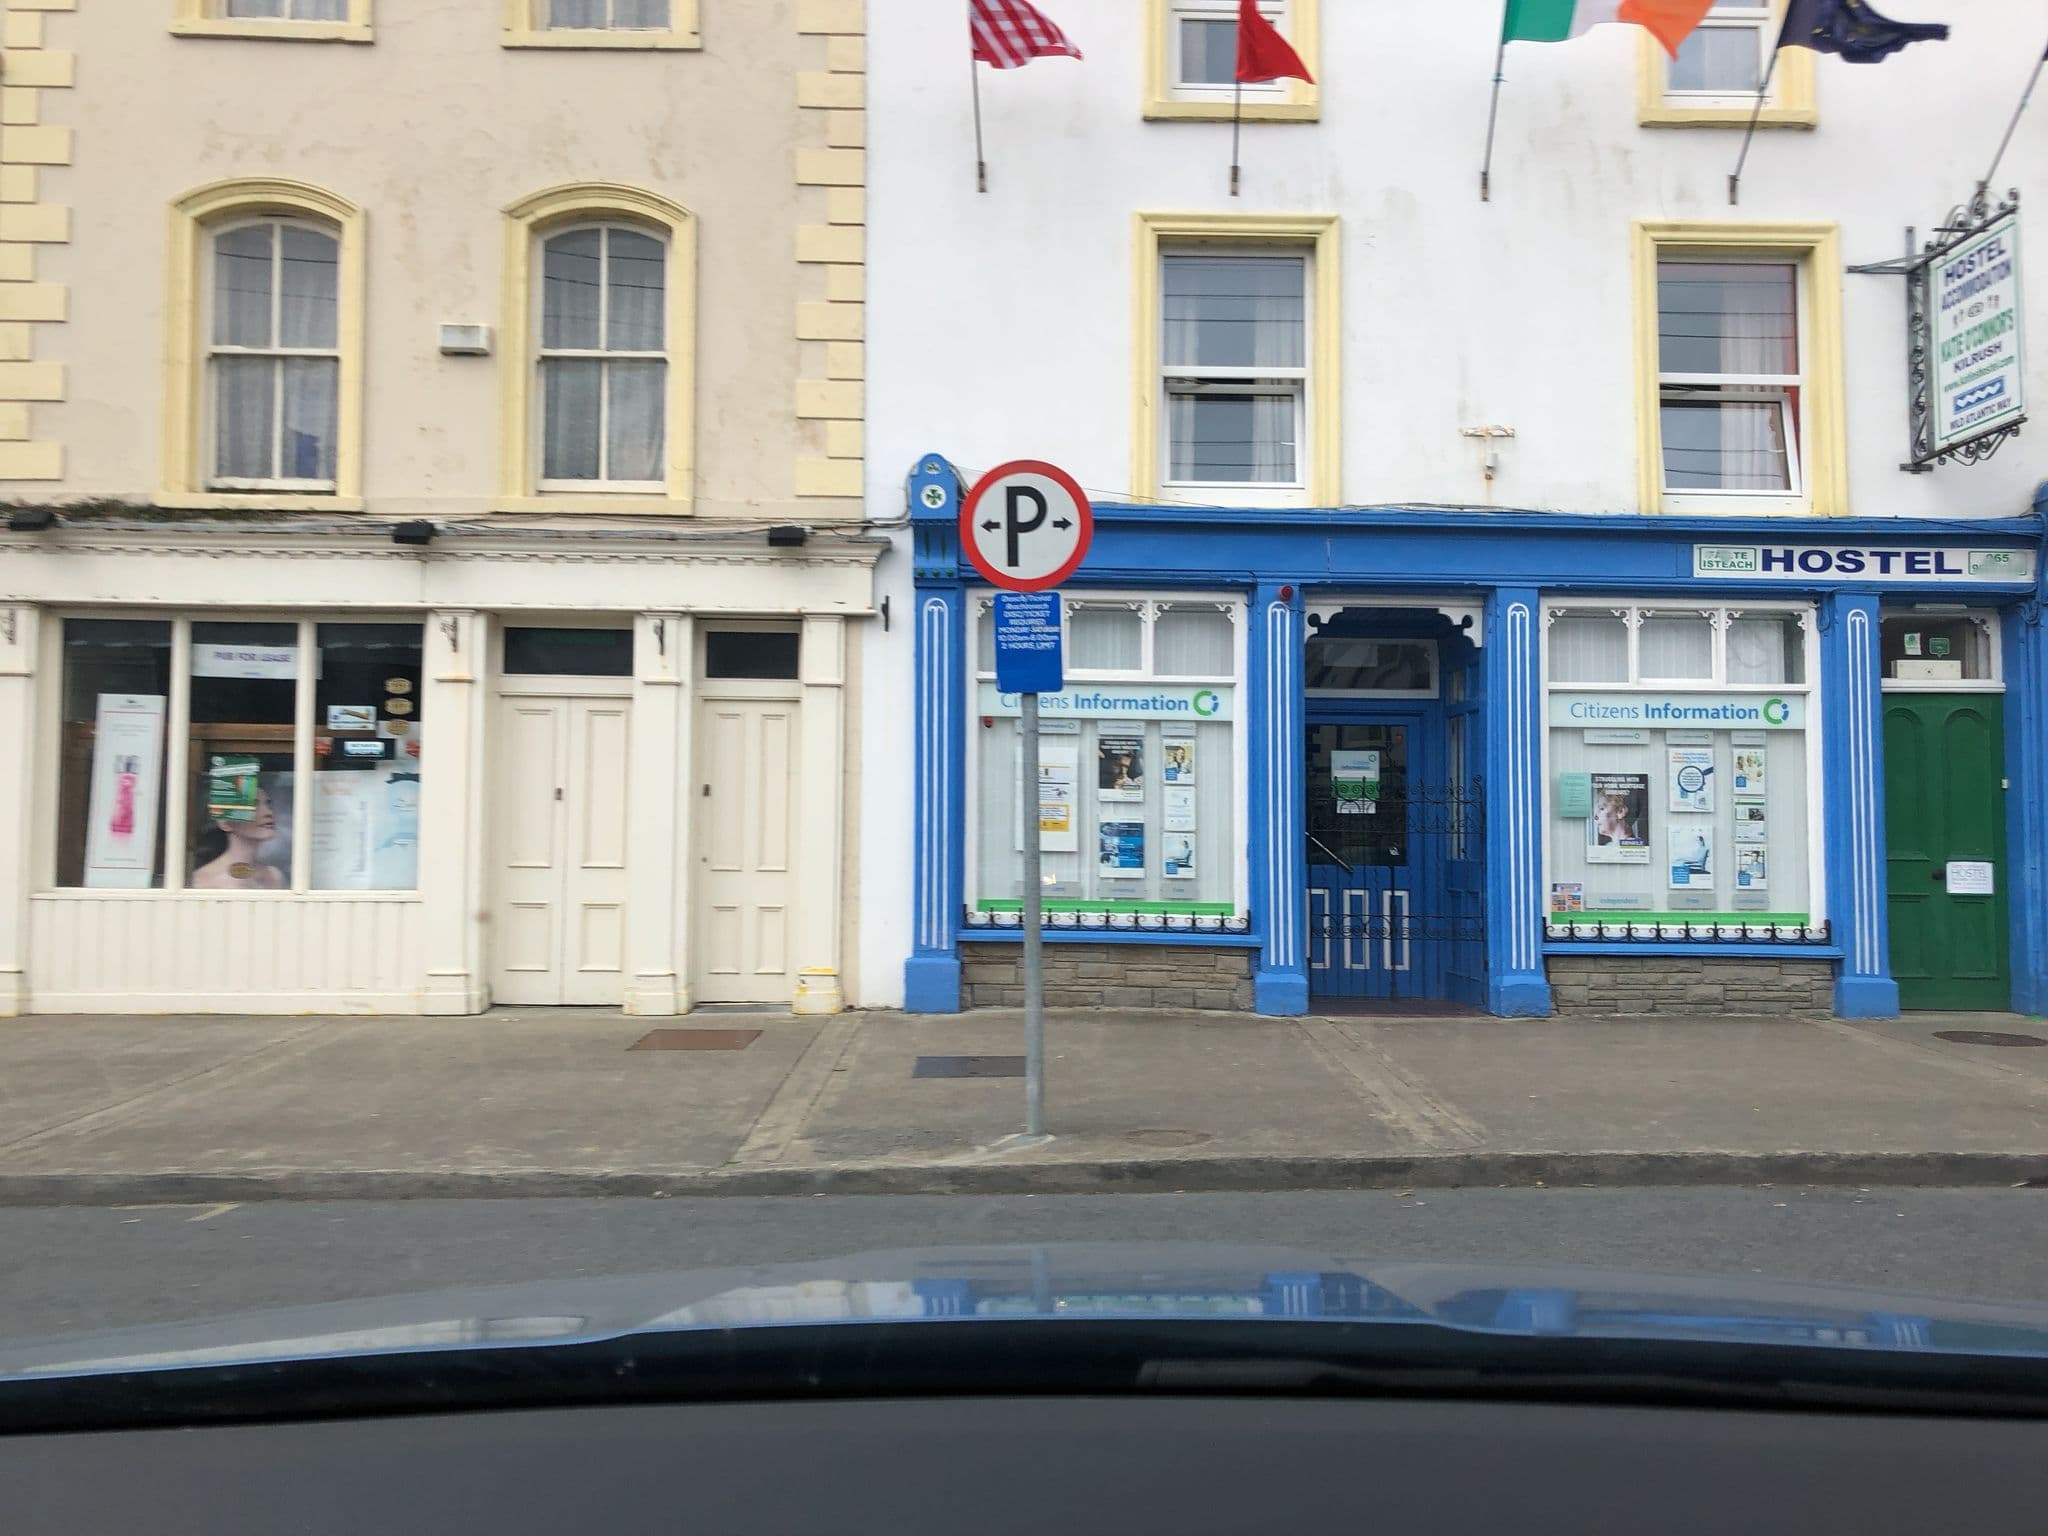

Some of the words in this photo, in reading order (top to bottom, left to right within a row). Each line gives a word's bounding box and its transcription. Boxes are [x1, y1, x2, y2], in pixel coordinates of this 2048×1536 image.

[1944, 238, 2006, 286] HOSTEL
[1954, 341, 2003, 373] KILRUSH
[1950, 415, 1964, 430] WILD
[1966, 403, 1996, 425] ATLANTIC
[1997, 396, 2012, 412] WAY
[1006, 485, 1048, 567] P
[1703, 560, 1753, 569] ISTEACH
[1761, 548, 1963, 575] HOSTEL
[1075, 692, 1189, 712] Information
[1570, 702, 1640, 719] Citizens
[1644, 703, 1759, 720] Information
